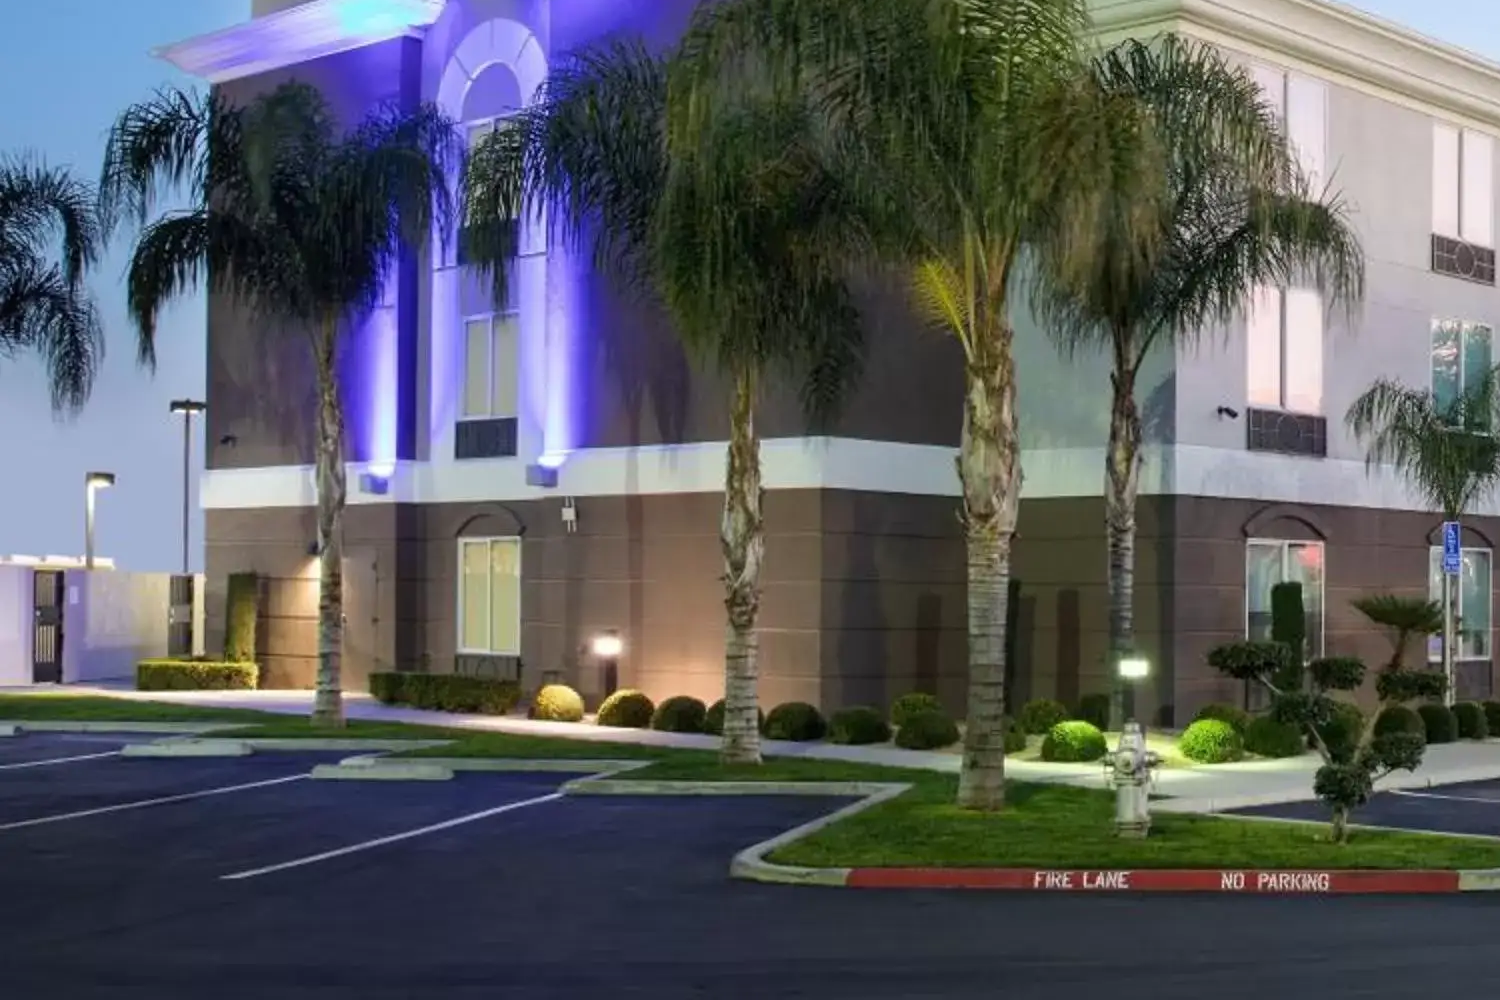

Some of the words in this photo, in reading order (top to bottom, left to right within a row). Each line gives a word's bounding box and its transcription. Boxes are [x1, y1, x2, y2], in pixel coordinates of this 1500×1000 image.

[1033, 871, 1073, 888] FIRE
[1083, 872, 1130, 889] LANE
[1221, 873, 1245, 889] NO
[1258, 873, 1330, 891] PARKING
